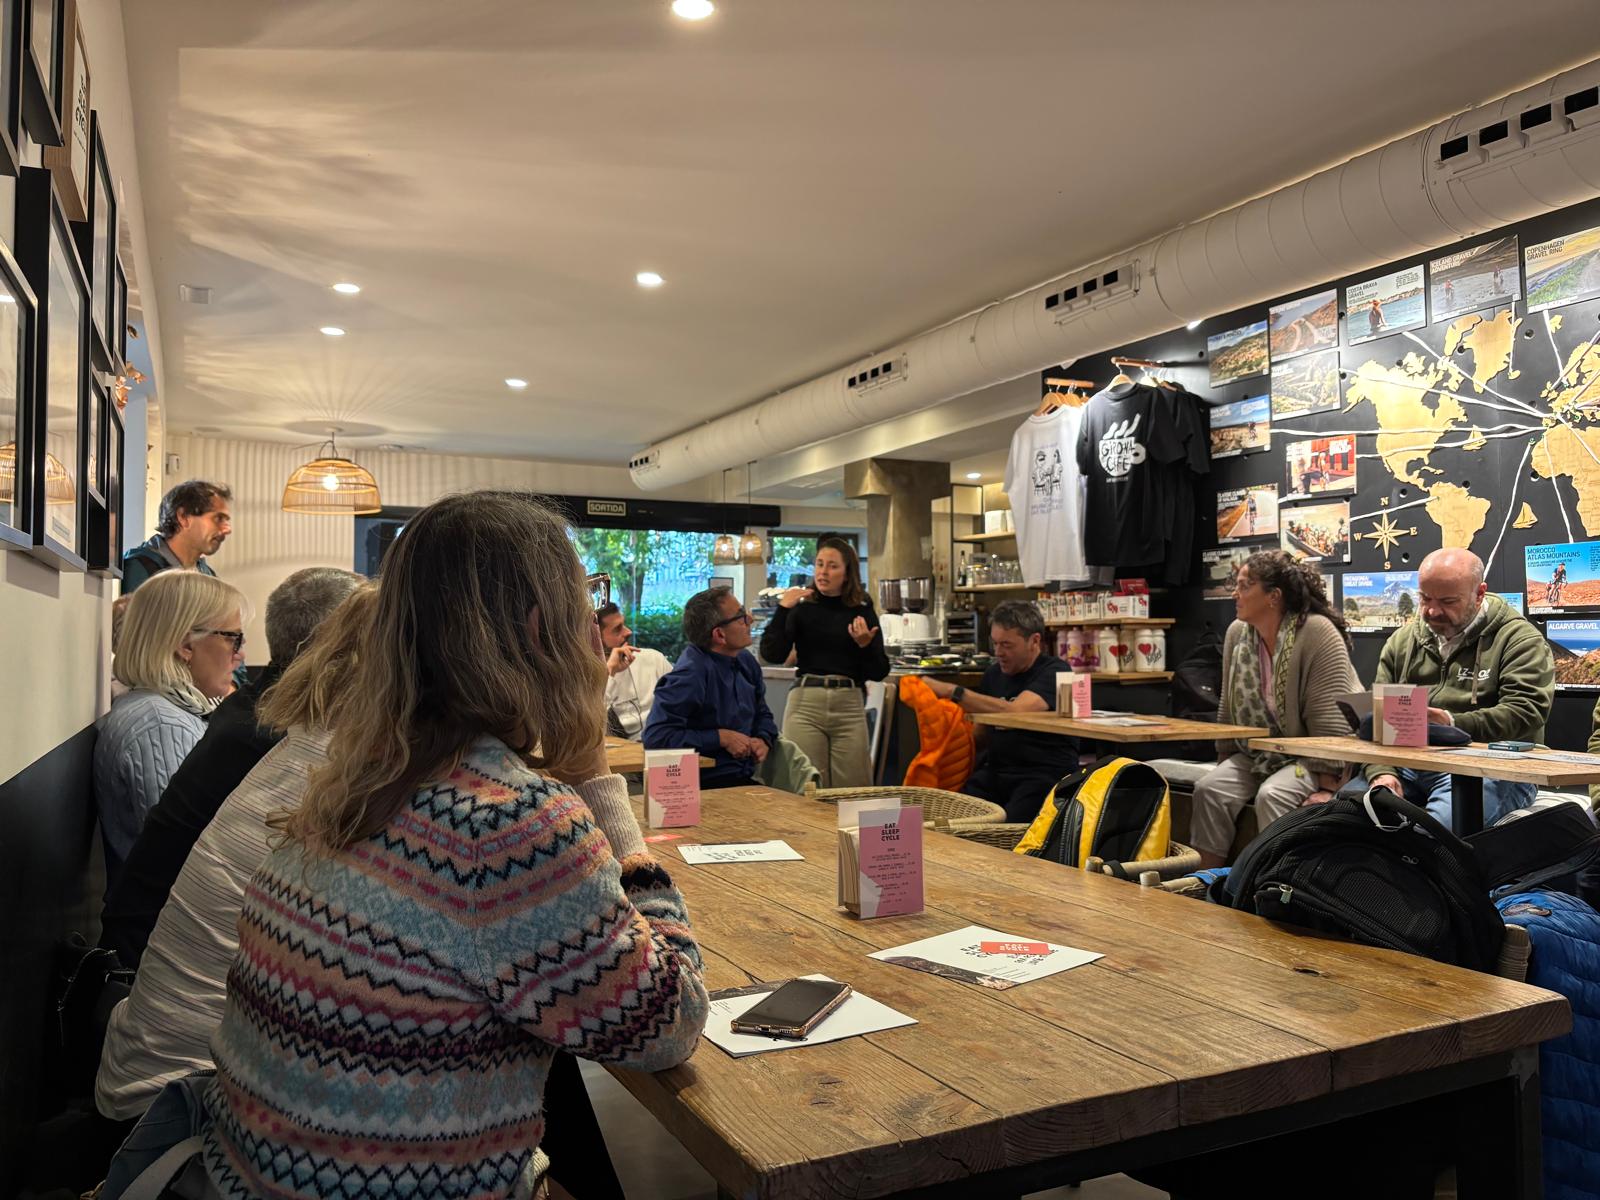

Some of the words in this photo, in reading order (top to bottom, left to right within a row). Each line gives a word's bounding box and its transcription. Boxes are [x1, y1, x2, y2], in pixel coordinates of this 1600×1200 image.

[1527, 240, 1564, 255] COPENHAGEN
[1527, 249, 1548, 261] GRAVEL
[1549, 246, 1563, 256] RING
[1431, 257, 1452, 267] ICELAND
[1431, 262, 1462, 272] ADVENTURE
[1347, 285, 1362, 295] COSTA
[1363, 281, 1378, 291] BRAVA
[1380, 497, 1389, 506] N
[590, 503, 624, 513] SORTIDA
[1353, 532, 1363, 541] W
[1410, 526, 1418, 536] E
[1527, 547, 1555, 555] MOROCCO
[1546, 551, 1581, 560] MOUNTAINS
[1384, 561, 1391, 570] S
[1548, 622, 1575, 631] ALGARVE
[1575, 622, 1599, 630] GRAVEL
[881, 828, 900, 836] SLEEP
[881, 834, 900, 842] CYCLE
